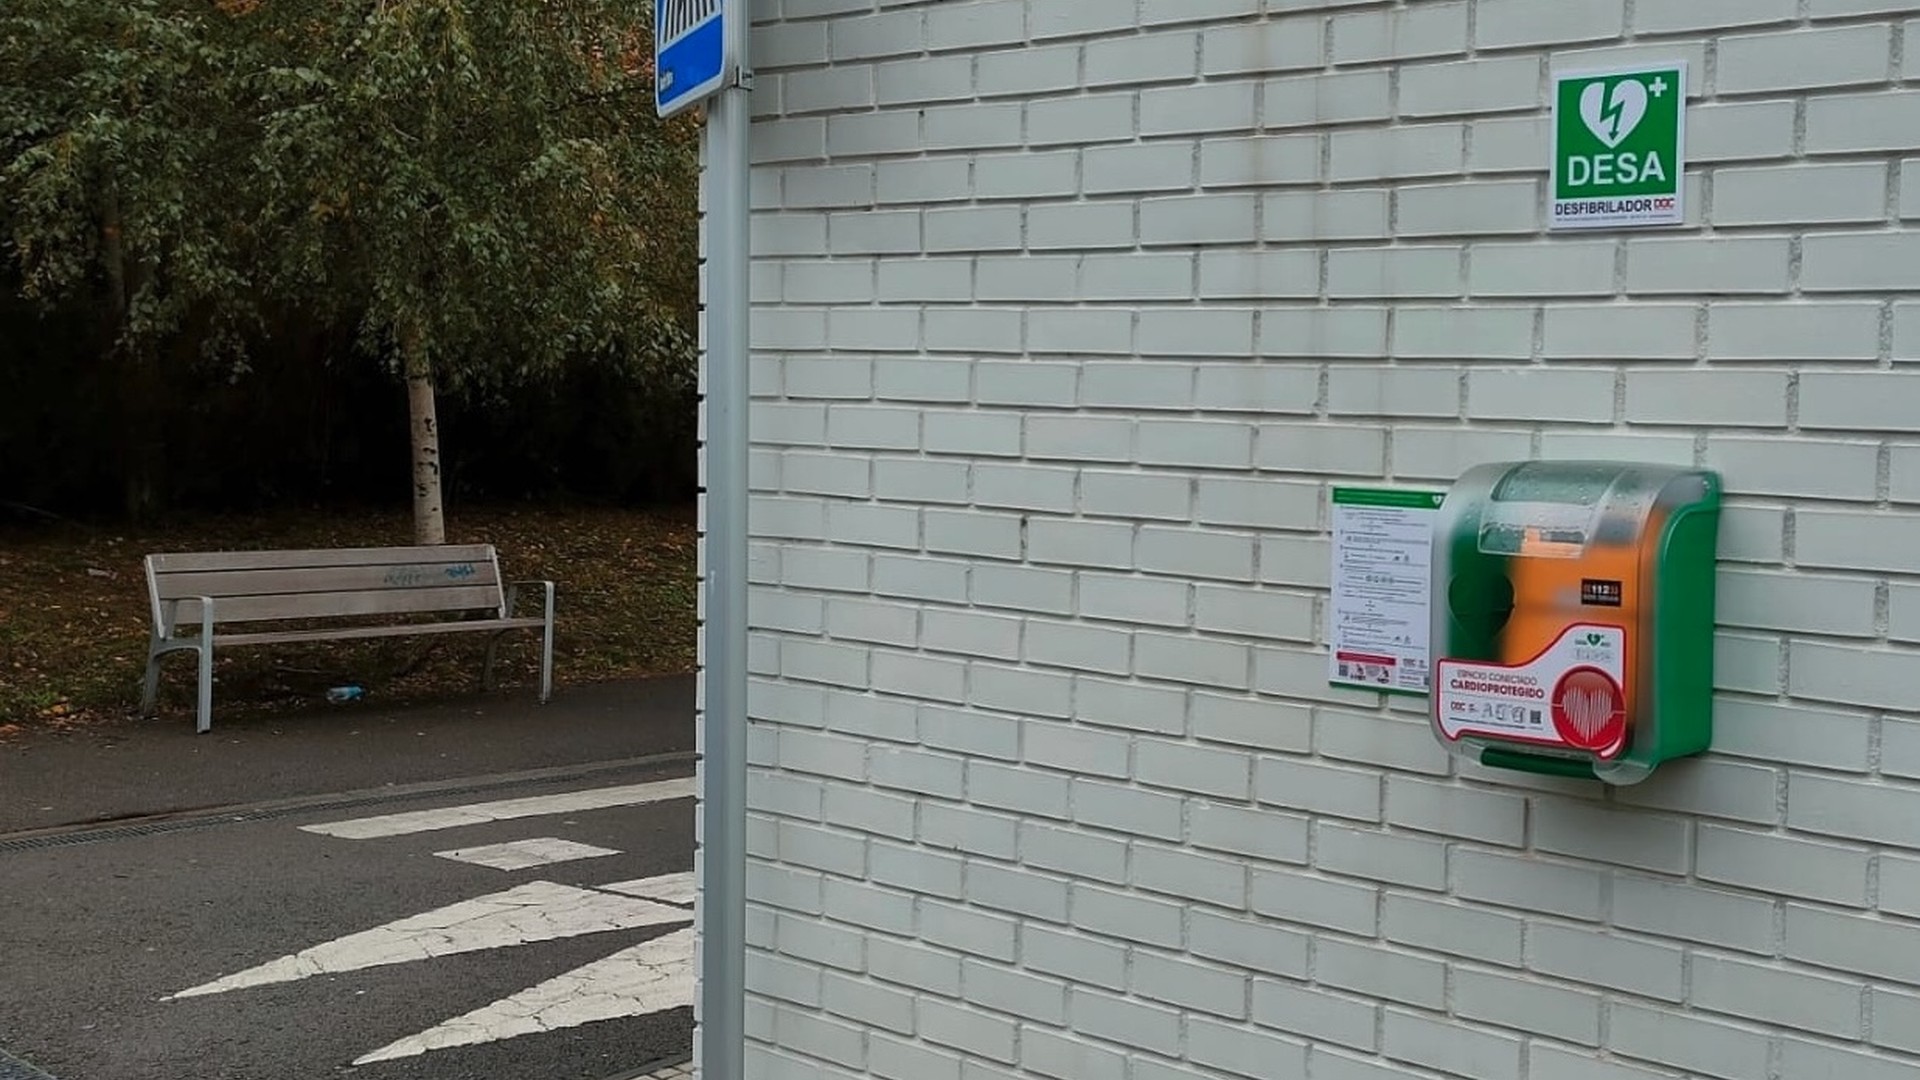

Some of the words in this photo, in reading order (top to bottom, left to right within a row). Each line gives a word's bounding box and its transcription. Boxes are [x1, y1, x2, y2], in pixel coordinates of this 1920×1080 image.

[1567, 151, 1666, 186] DESA
[1555, 199, 1652, 216] DESFIBRILADOR
[1592, 585, 1610, 594] 112
[1457, 669, 1487, 680] ESPACIO
[1489, 672, 1538, 686] CONECTADO
[1450, 679, 1545, 699] CARDIOPROTEGIDO
